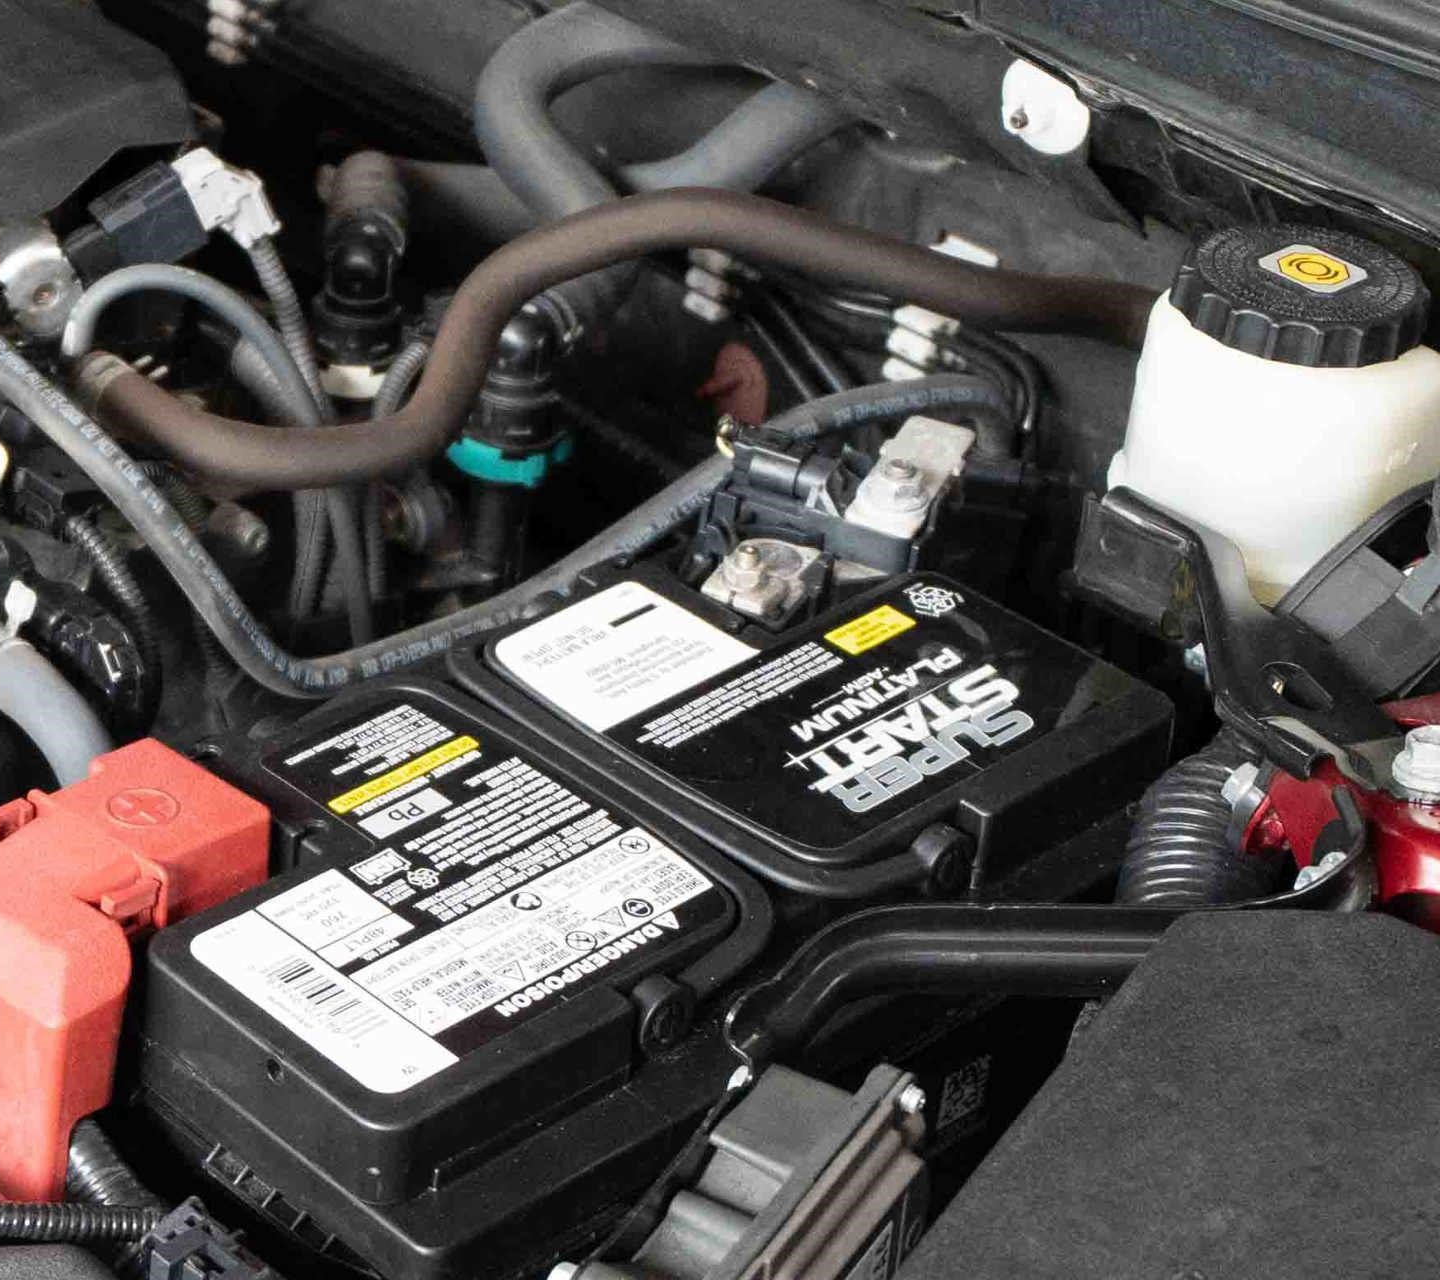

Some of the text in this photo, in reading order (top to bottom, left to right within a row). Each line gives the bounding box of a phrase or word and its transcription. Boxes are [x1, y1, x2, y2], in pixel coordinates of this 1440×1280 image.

[789, 645, 969, 743] PLATINUM
[808, 661, 1020, 793] START
[827, 703, 1034, 814] SUPER
[387, 803, 424, 822] Pb
[386, 957, 470, 1001] MEDICAL HELP FAST
[432, 969, 484, 996] WITH WATER
[496, 920, 662, 1018] DANGER/POISON
[439, 977, 494, 1006] IMMEDIATELY
[456, 984, 507, 1011] FLUSH EYES
